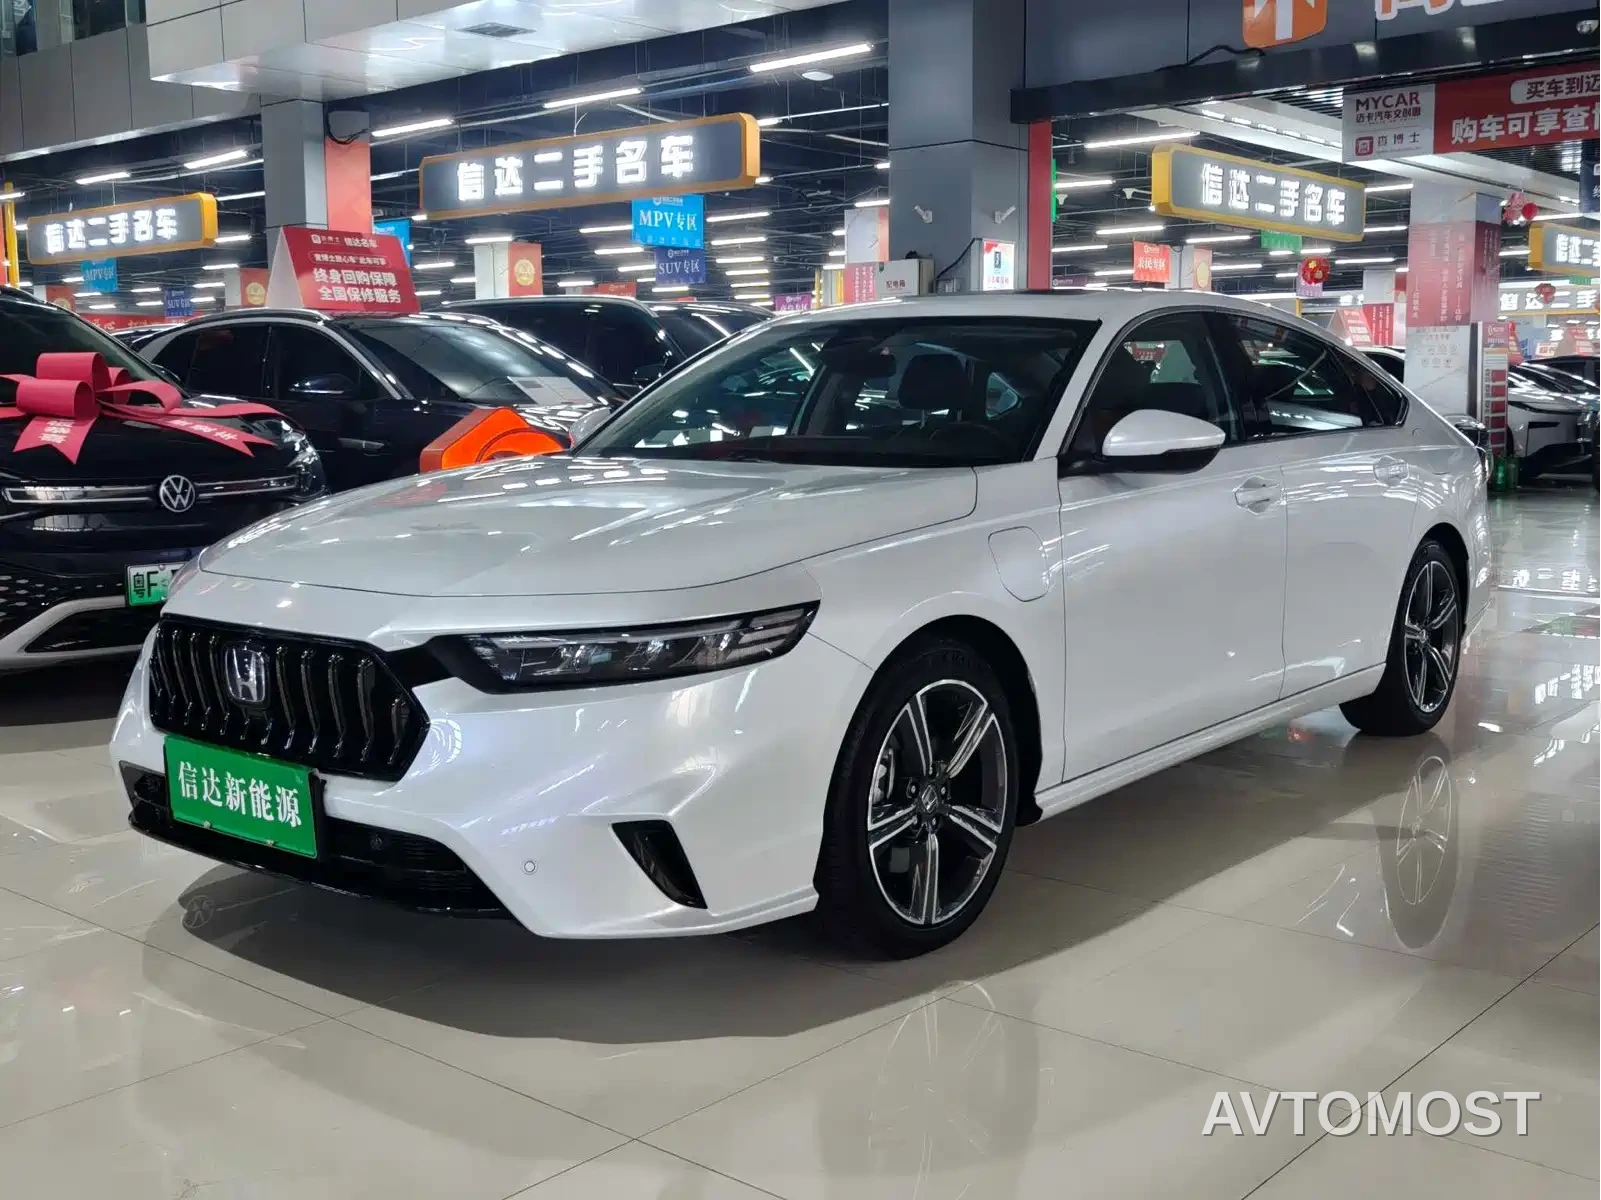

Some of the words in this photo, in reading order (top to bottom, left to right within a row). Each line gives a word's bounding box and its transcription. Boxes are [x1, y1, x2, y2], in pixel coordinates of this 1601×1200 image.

[1355, 91, 1421, 112] MYCAR
[457, 134, 694, 202] 信达二手名车
[1200, 162, 1347, 227] 信达二手名车
[639, 209, 698, 231] MPV专区
[45, 208, 178, 255] 信达二手名车
[313, 267, 397, 287] 终身回购保障
[659, 259, 700, 274] SUV专区
[318, 286, 401, 304] 全国保修服务
[178, 761, 302, 828] 信达新能源
